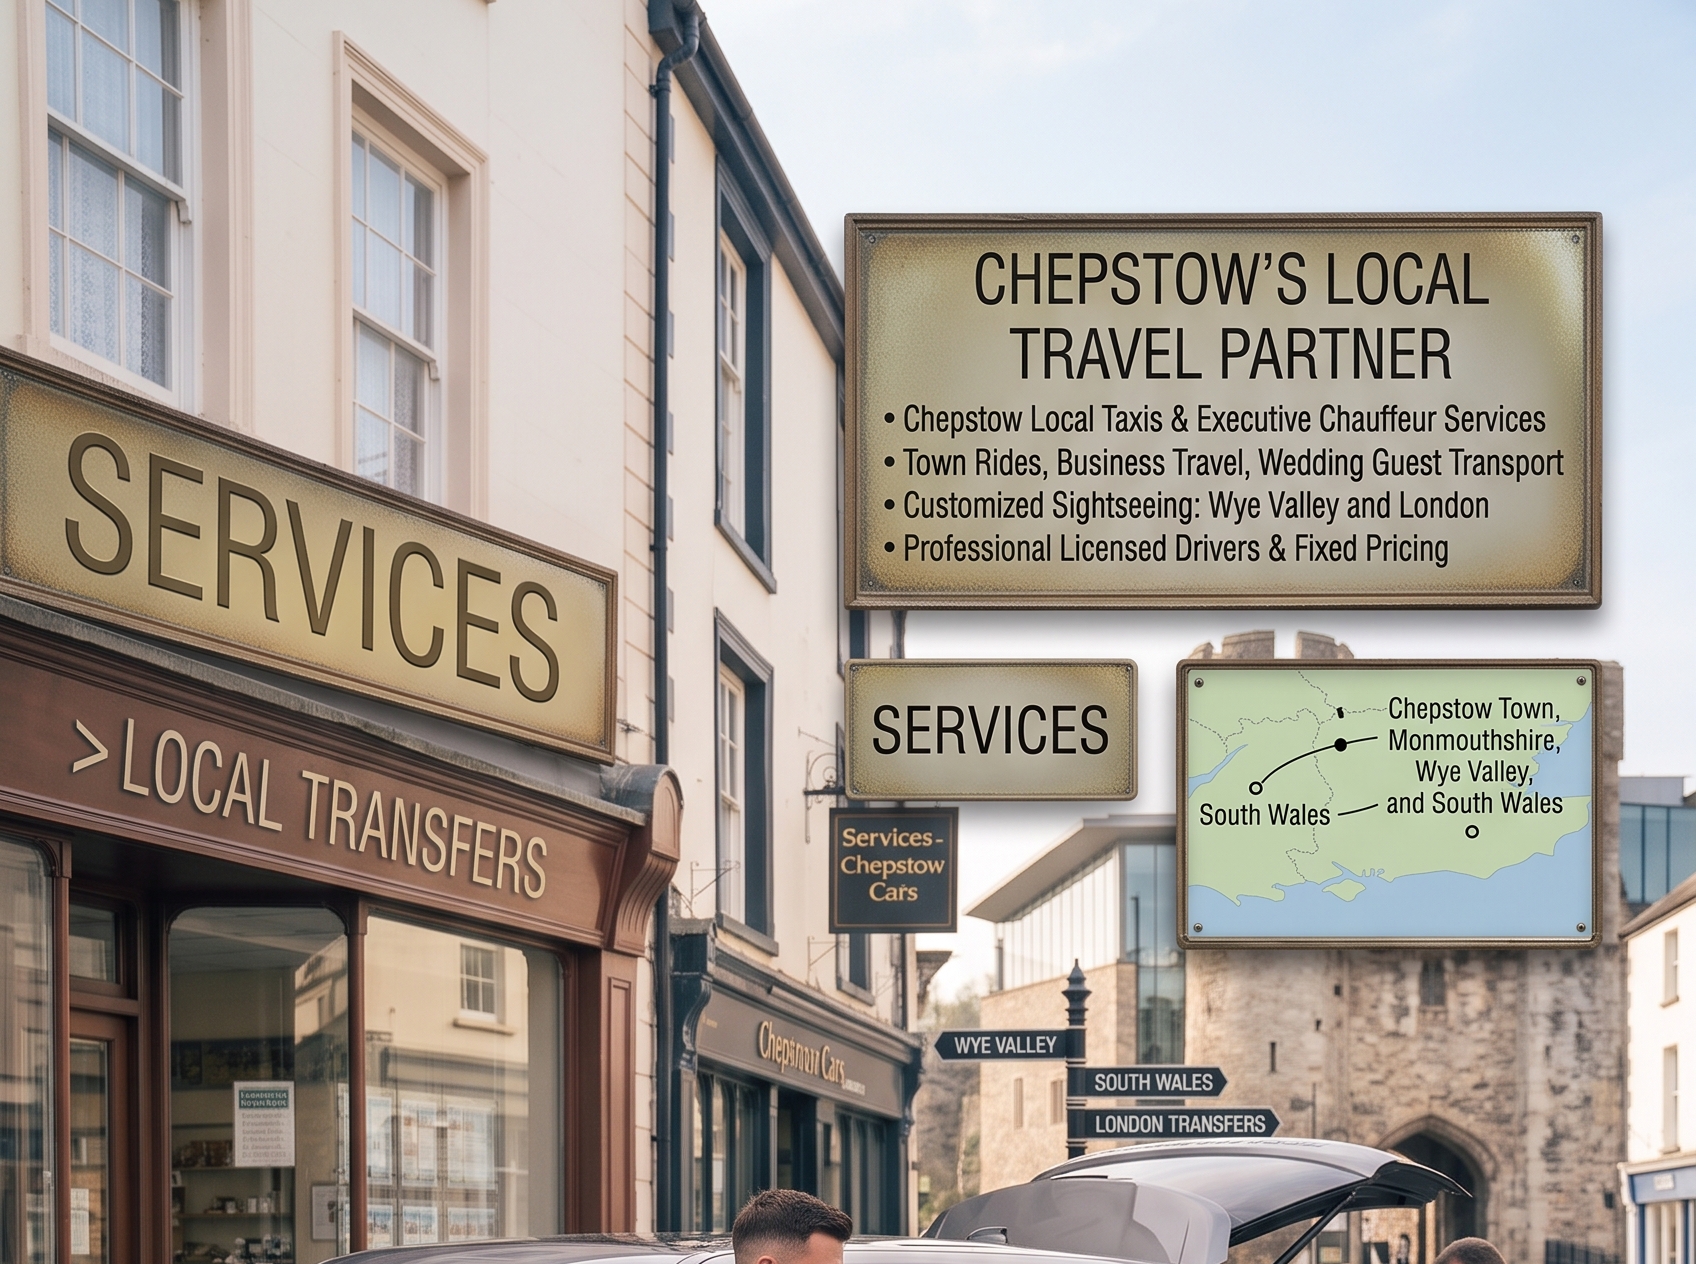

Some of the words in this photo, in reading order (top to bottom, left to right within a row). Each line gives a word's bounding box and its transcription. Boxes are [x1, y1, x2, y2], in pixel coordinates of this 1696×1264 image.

[975, 251, 1307, 306] CHEPSTOW'S
[1327, 251, 1490, 306] LOCAL
[1009, 327, 1203, 380] TRAVEL
[1221, 327, 1452, 380] PARTNER
[903, 403, 1023, 439] Chepstow
[1031, 404, 1094, 433] Local
[1101, 404, 1163, 433] Taxis
[1171, 404, 1189, 433] &
[1198, 404, 1311, 433] Executive
[1319, 403, 1438, 433] Chauffeur
[1444, 404, 1546, 433] Services
[902, 448, 966, 476] Town
[975, 448, 1048, 481] Rides,
[1057, 448, 1165, 476] Business
[1172, 448, 1250, 481] Travel,
[1258, 447, 1364, 483] Wedding
[1372, 447, 1442, 477] Guest
[1448, 448, 1565, 483] Transport
[904, 490, 1044, 519] Customized
[1052, 490, 1200, 526] Sightseeing:
[1208, 490, 1261, 525] Wye
[1268, 490, 1340, 526] Valley
[1347, 490, 1390, 519] and
[1400, 490, 1489, 519] London
[904, 533, 1051, 562] Professional
[1060, 533, 1166, 562] Licensed
[1176, 533, 1260, 562] Drivers
[1268, 533, 1287, 562] &
[1295, 533, 1357, 562] Fixed
[1366, 533, 1448, 569] Pricing
[65, 432, 560, 703] SERVICES
[1389, 696, 1493, 725] Chepstow
[1498, 697, 1560, 723] Town,
[872, 704, 1109, 755] SERVICES
[1389, 728, 1561, 755] Monmouthshire,
[1415, 760, 1461, 787] Wye
[1467, 759, 1533, 788] Valley,
[122, 717, 283, 832] LOCAL
[301, 769, 548, 899] TRANSFERS
[1200, 803, 1260, 826] South
[1267, 803, 1331, 826] Wales
[1386, 791, 1424, 814] and
[1432, 791, 1493, 814] South
[1500, 791, 1563, 814] Wales
[840, 854, 946, 880] Chepstow
[954, 1035, 991, 1054] WYE
[994, 1035, 1057, 1054] VALLEY
[1094, 1073, 1151, 1092] SOUTH
[1155, 1073, 1214, 1092] WALES
[1095, 1114, 1164, 1134] LONDON
[1167, 1114, 1267, 1134] TRANSFERS
